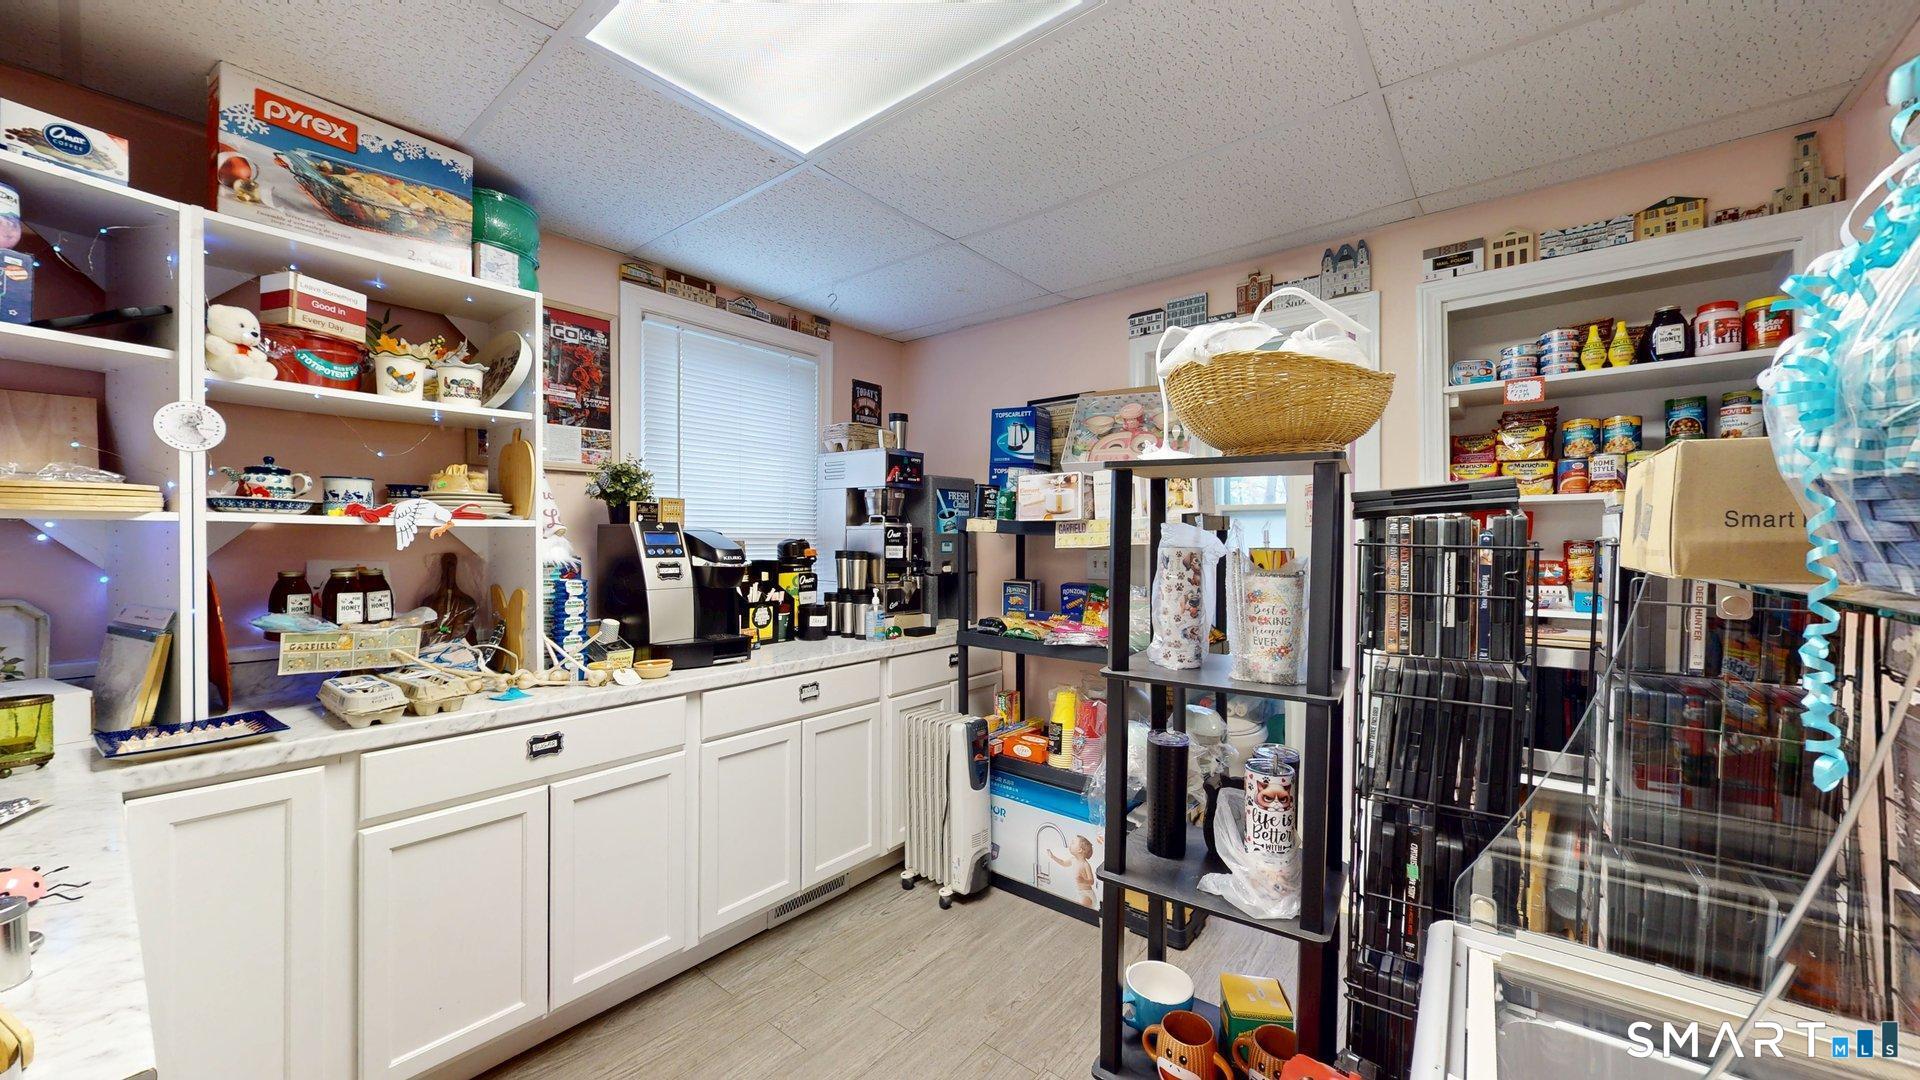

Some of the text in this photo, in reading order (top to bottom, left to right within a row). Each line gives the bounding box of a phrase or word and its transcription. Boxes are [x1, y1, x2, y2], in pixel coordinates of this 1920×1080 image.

[263, 100, 349, 144] pyrex
[49, 126, 87, 145] Omar
[52, 137, 83, 152] COFFEE
[311, 300, 346, 316] Good in
[302, 314, 344, 333] Every Day
[552, 325, 578, 339] GO
[994, 410, 1032, 419] TOPSCARLETT
[1720, 408, 1750, 416] NOVER
[948, 491, 969, 500] FRESH
[1724, 510, 1796, 529] Smart
[1058, 523, 1087, 534] GARFIELD
[1693, 608, 1704, 641] HUNTER
[289, 642, 337, 651] GARFIELD
[1253, 637, 1280, 647] EVER
[1281, 811, 1294, 827] is
[1252, 824, 1294, 845] Better
[1410, 843, 1419, 865] CAPITALIS
